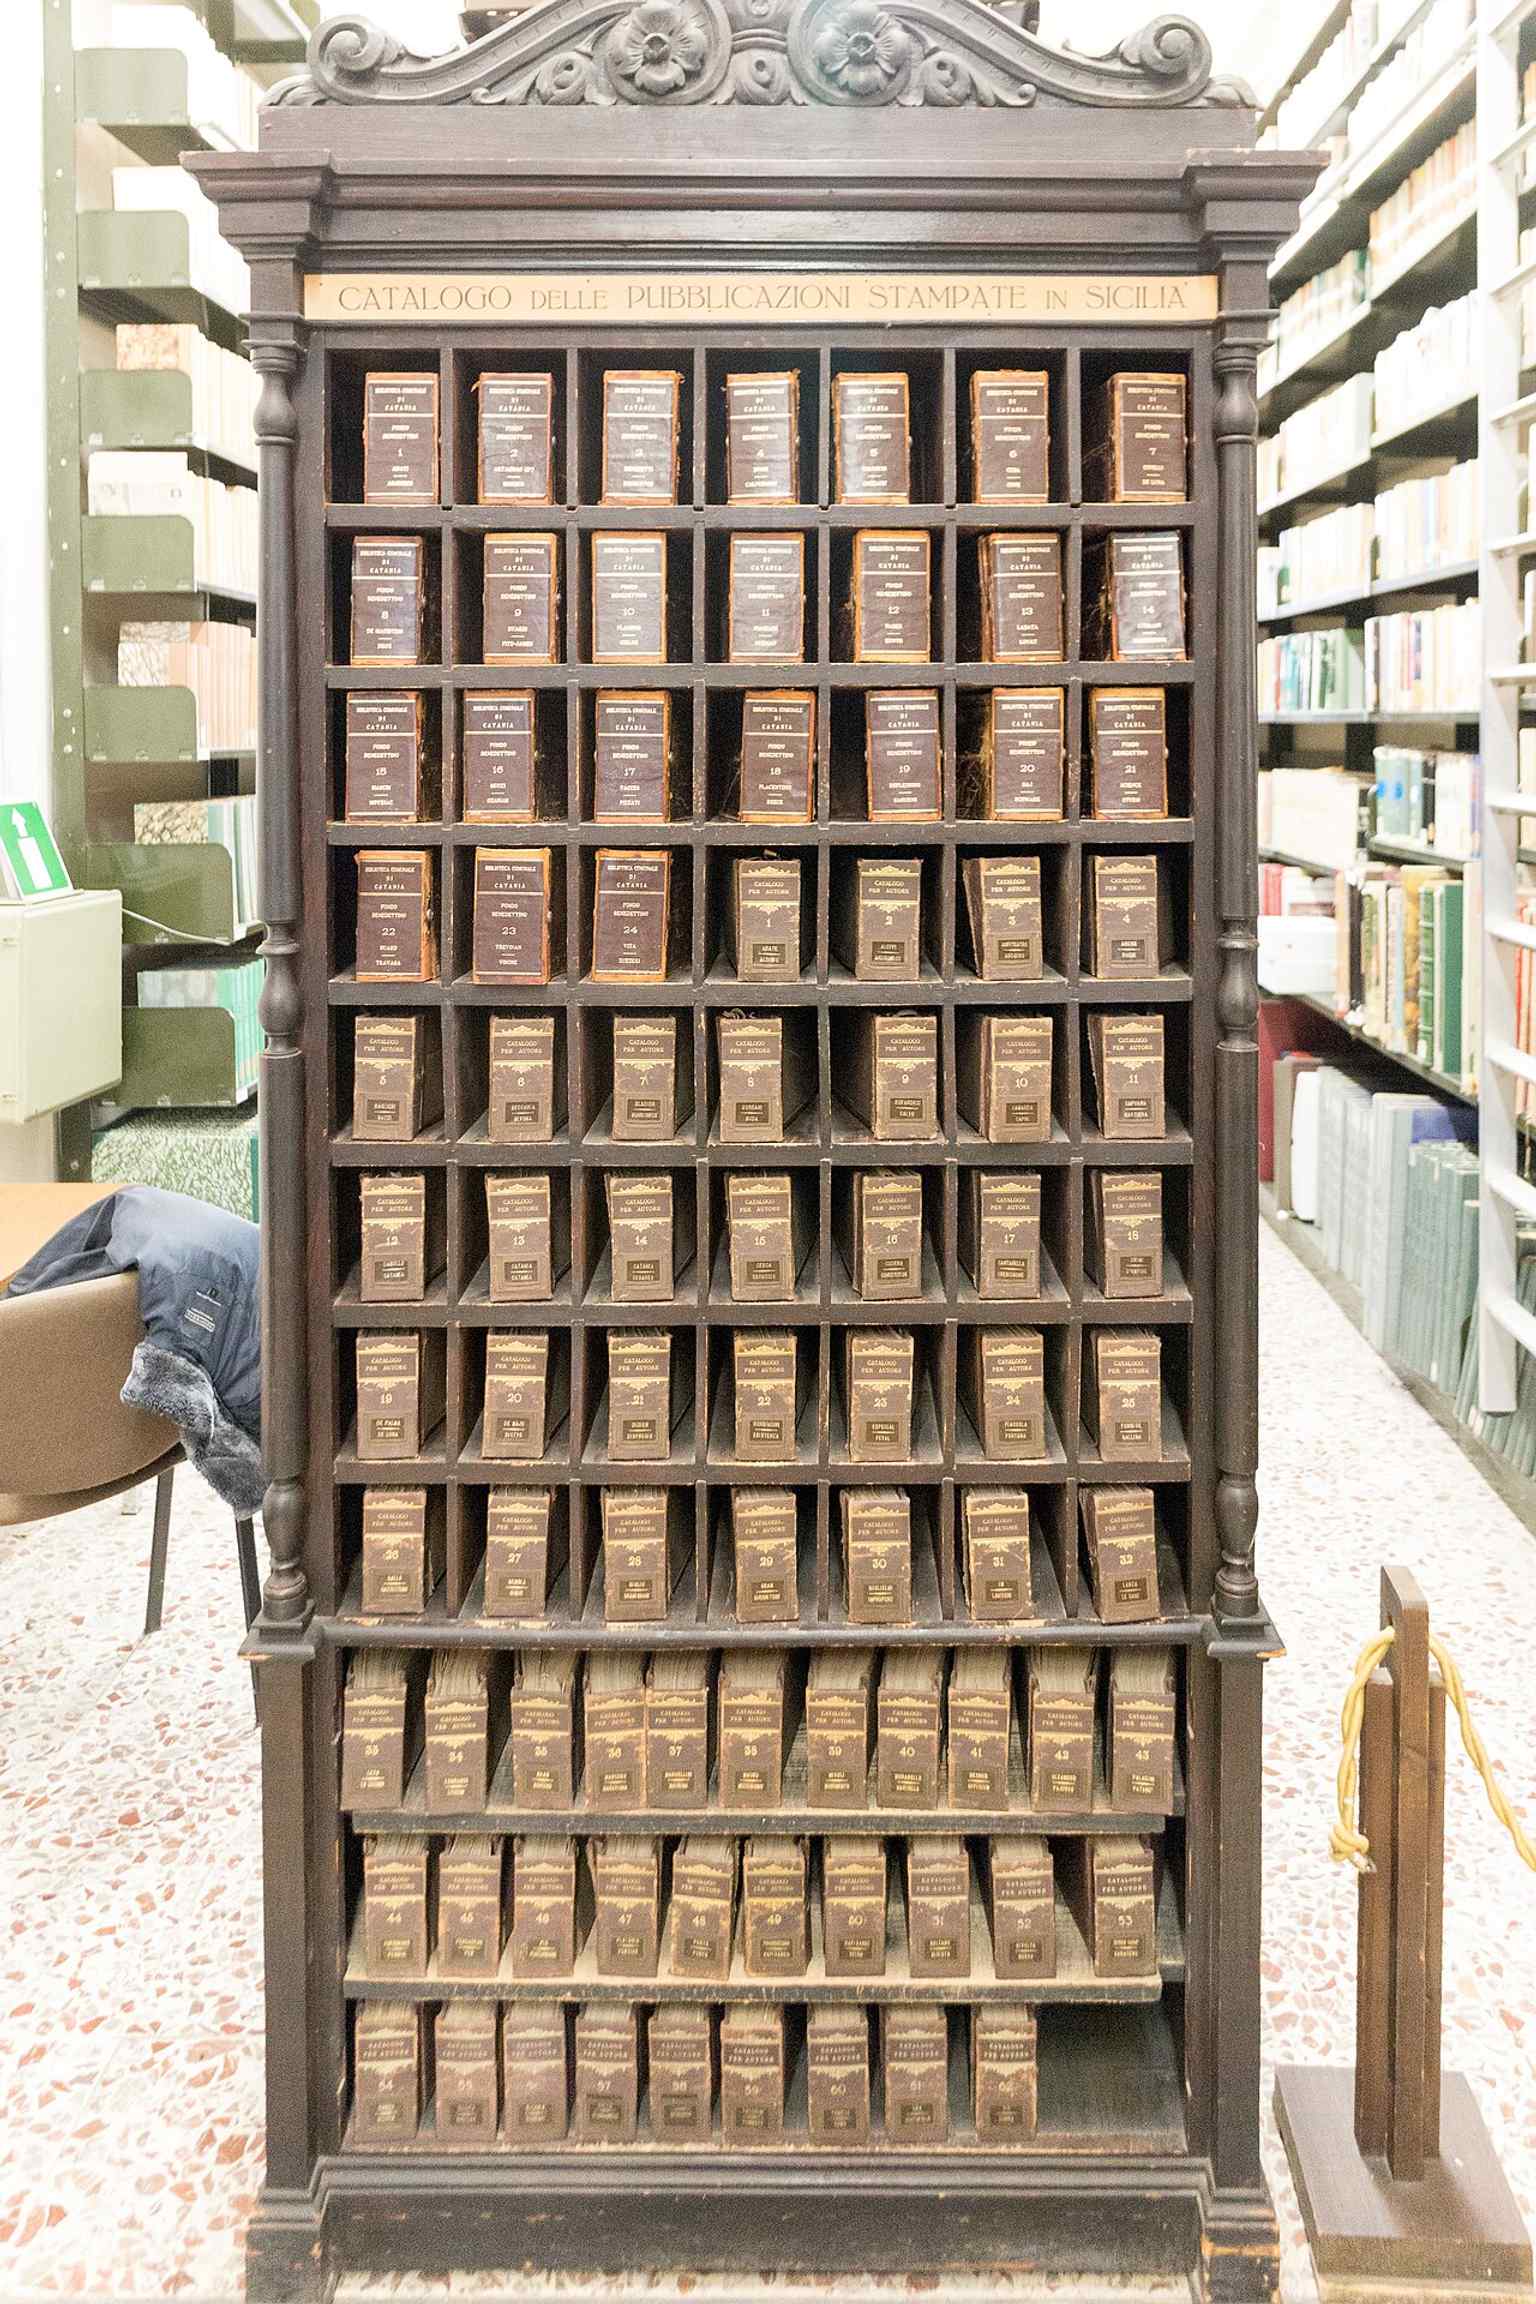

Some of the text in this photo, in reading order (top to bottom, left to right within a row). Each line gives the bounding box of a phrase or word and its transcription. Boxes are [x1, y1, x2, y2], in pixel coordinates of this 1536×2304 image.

[338, 284, 1187, 312] CATALOGO DELLE PUBBLICAZIONI STAMPATE IN SICILIA
[398, 448, 403, 456] 1
[1009, 450, 1017, 458] 6
[622, 608, 635, 616] 10
[888, 606, 900, 614] 12
[624, 768, 636, 776] 17
[771, 767, 781, 775] 18
[899, 765, 910, 773] 19
[1125, 765, 1136, 773] 21
[767, 919, 771, 927] 1
[885, 916, 892, 925] 2
[1008, 916, 1016, 926] 3
[1123, 914, 1130, 923] 4
[382, 928, 395, 936] 22
[502, 927, 516, 935] 23
[370, 1039, 399, 1047] CATALOGO
[902, 1074, 909, 1083] 9
[1016, 1078, 1028, 1088] 10
[1127, 1074, 1139, 1083] 11
[377, 1199, 407, 1207] CATALOGO
[503, 1199, 534, 1207] CATALOGO
[995, 1198, 1025, 1206] CATALOGO
[512, 1236, 525, 1245] 13
[635, 1236, 648, 1245] 14
[1005, 1234, 1015, 1243] 17
[381, 1394, 392, 1404] 19
[507, 1393, 522, 1403] 20
[633, 1395, 644, 1405] 21
[758, 1397, 771, 1406] 22
[1006, 1395, 1020, 1405] 24
[508, 1553, 521, 1563] 27
[760, 1557, 773, 1566] 29
[993, 1557, 1004, 1567] 31
[1120, 1554, 1133, 1565] 32
[872, 1559, 887, 1568] 30
[1127, 1714, 1158, 1722] CATALOGO
[670, 1746, 682, 1756] 37
[900, 1747, 915, 1757] 40
[971, 1748, 982, 1757] 41
[1055, 1751, 1069, 1760] 42
[1136, 1750, 1149, 1760] 43
[1108, 1877, 1142, 1886] CATALOGO
[387, 1913, 401, 1923] 44
[618, 1911, 632, 1924] 47
[1118, 1916, 1132, 1926] 53
[1017, 1919, 1031, 1929] 52
[831, 2085, 846, 2094] 60
